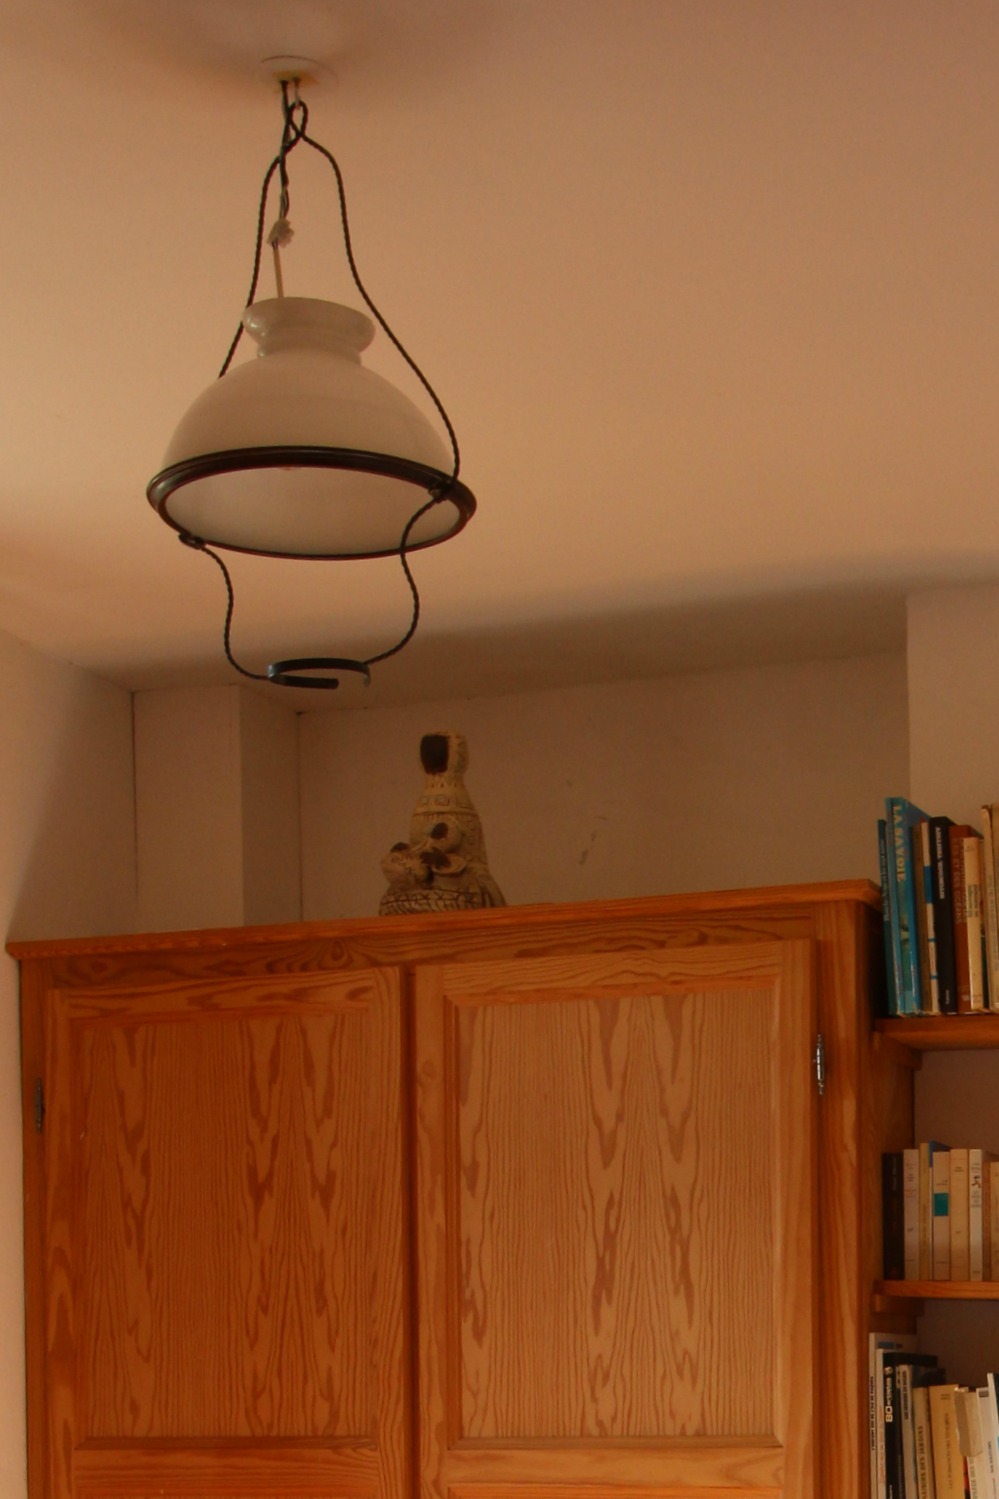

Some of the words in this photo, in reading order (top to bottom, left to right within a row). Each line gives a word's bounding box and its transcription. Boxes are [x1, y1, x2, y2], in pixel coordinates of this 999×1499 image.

[892, 804, 902, 824] LA
[893, 826, 906, 882] SAVOIE
[916, 1424, 925, 1454] JARDINS
